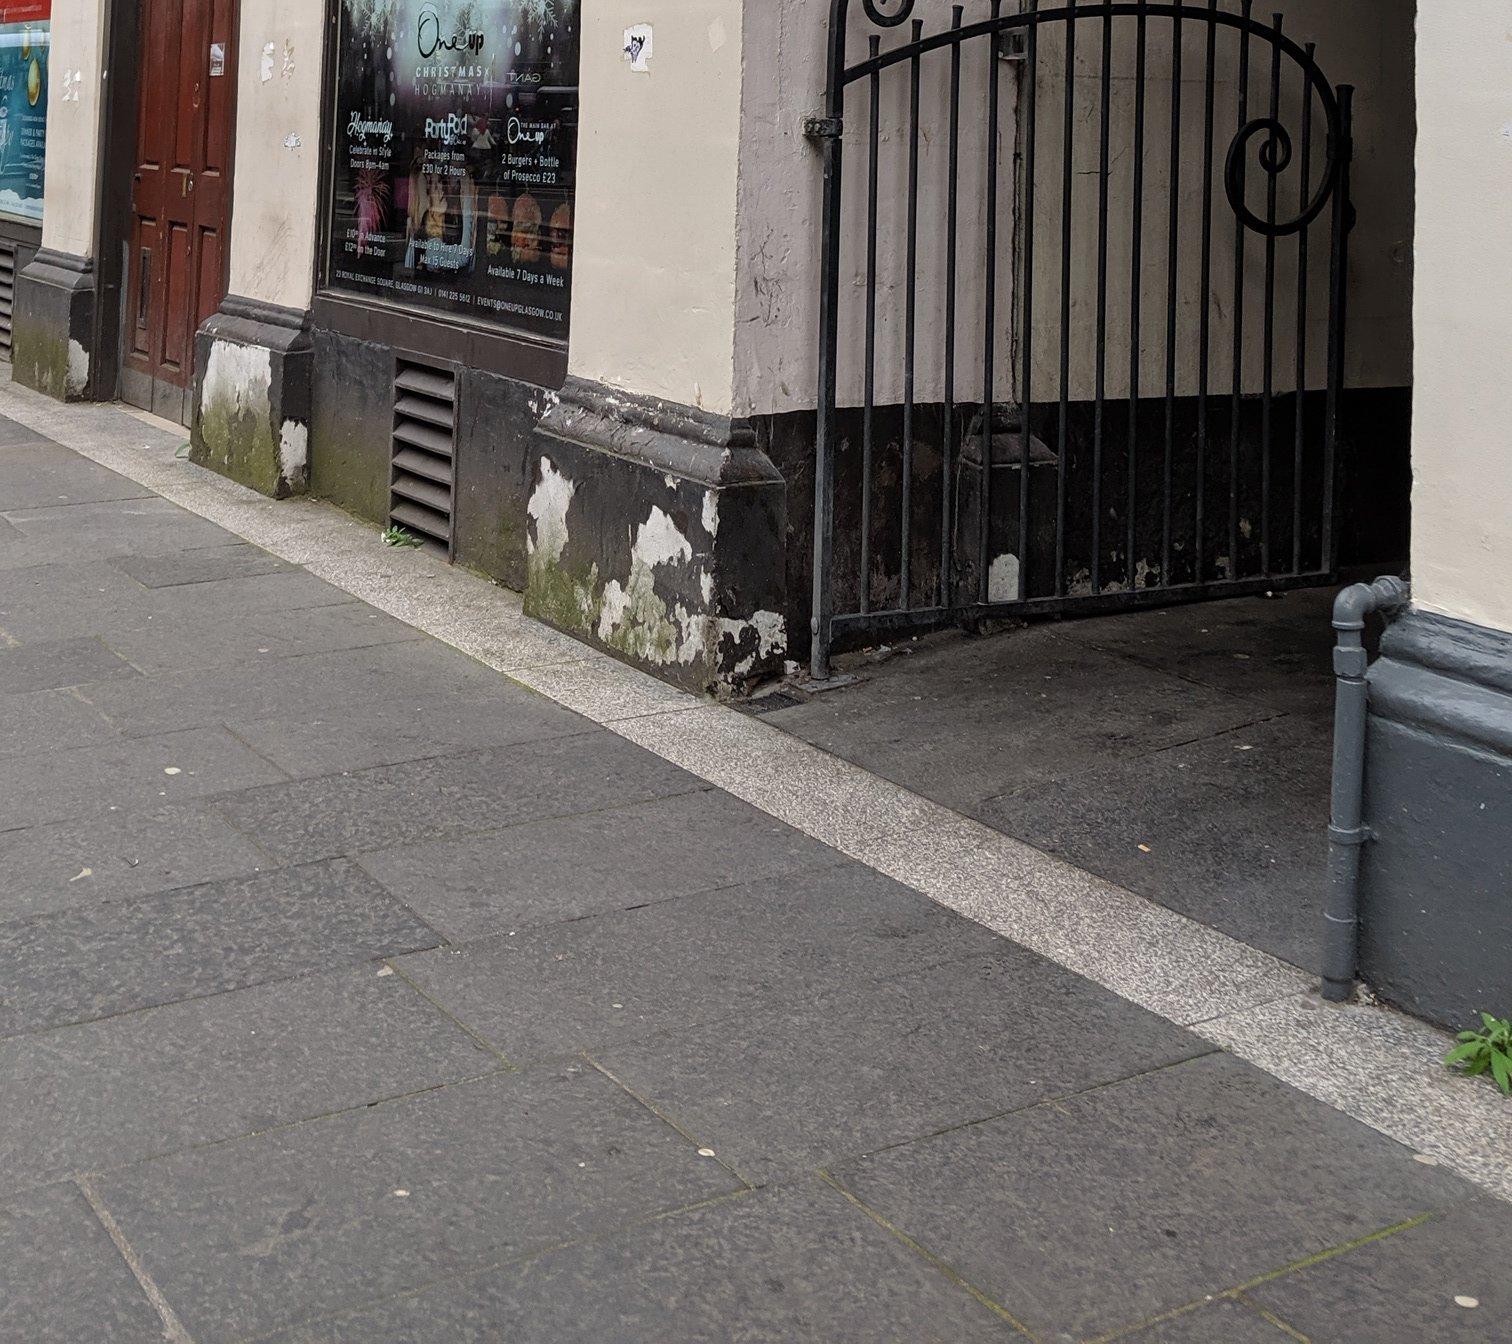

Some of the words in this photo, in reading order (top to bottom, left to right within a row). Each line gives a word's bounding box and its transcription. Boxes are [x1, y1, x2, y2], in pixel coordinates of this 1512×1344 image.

[418, 10, 469, 58] One
[469, 31, 485, 56] up
[415, 65, 482, 78] CHRISTMAS
[414, 83, 482, 96] HOGMANAY
[347, 110, 394, 143] Hogmanay
[507, 117, 536, 144] One
[535, 131, 545, 145] up
[349, 145, 372, 156] Celebrate
[379, 146, 392, 158] Style
[424, 149, 450, 162] Packages
[451, 150, 465, 162] from
[350, 158, 365, 169] Doors
[501, 153, 506, 164] 2
[508, 153, 532, 168] Burgers
[540, 155, 559, 167] Bottle
[422, 163, 434, 174] £30
[434, 164, 443, 175] for
[444, 164, 449, 175] 2
[449, 165, 467, 176] Hours
[503, 170, 510, 181] of
[511, 170, 541, 183] Prosecco
[543, 172, 556, 184] £23
[365, 231, 386, 243] Advance
[365, 245, 373, 255] the
[374, 246, 386, 257] Door
[409, 239, 433, 251] Available
[458, 244, 473, 258] Days
[440, 256, 459, 270] Guests
[488, 264, 515, 279] Available
[517, 268, 521, 280] 7
[522, 269, 538, 285] Days
[540, 274, 544, 283] a
[546, 273, 564, 287] Week
[342, 270, 354, 280] ROYAL
[355, 272, 376, 285] EXCHANGE
[395, 280, 417, 292] GLASGOW
[438, 288, 449, 297] 0141
[449, 290, 459, 301] 225
[477, 296, 563, 322] EVENTS@ONEUPGLASGOW.CO.UK
